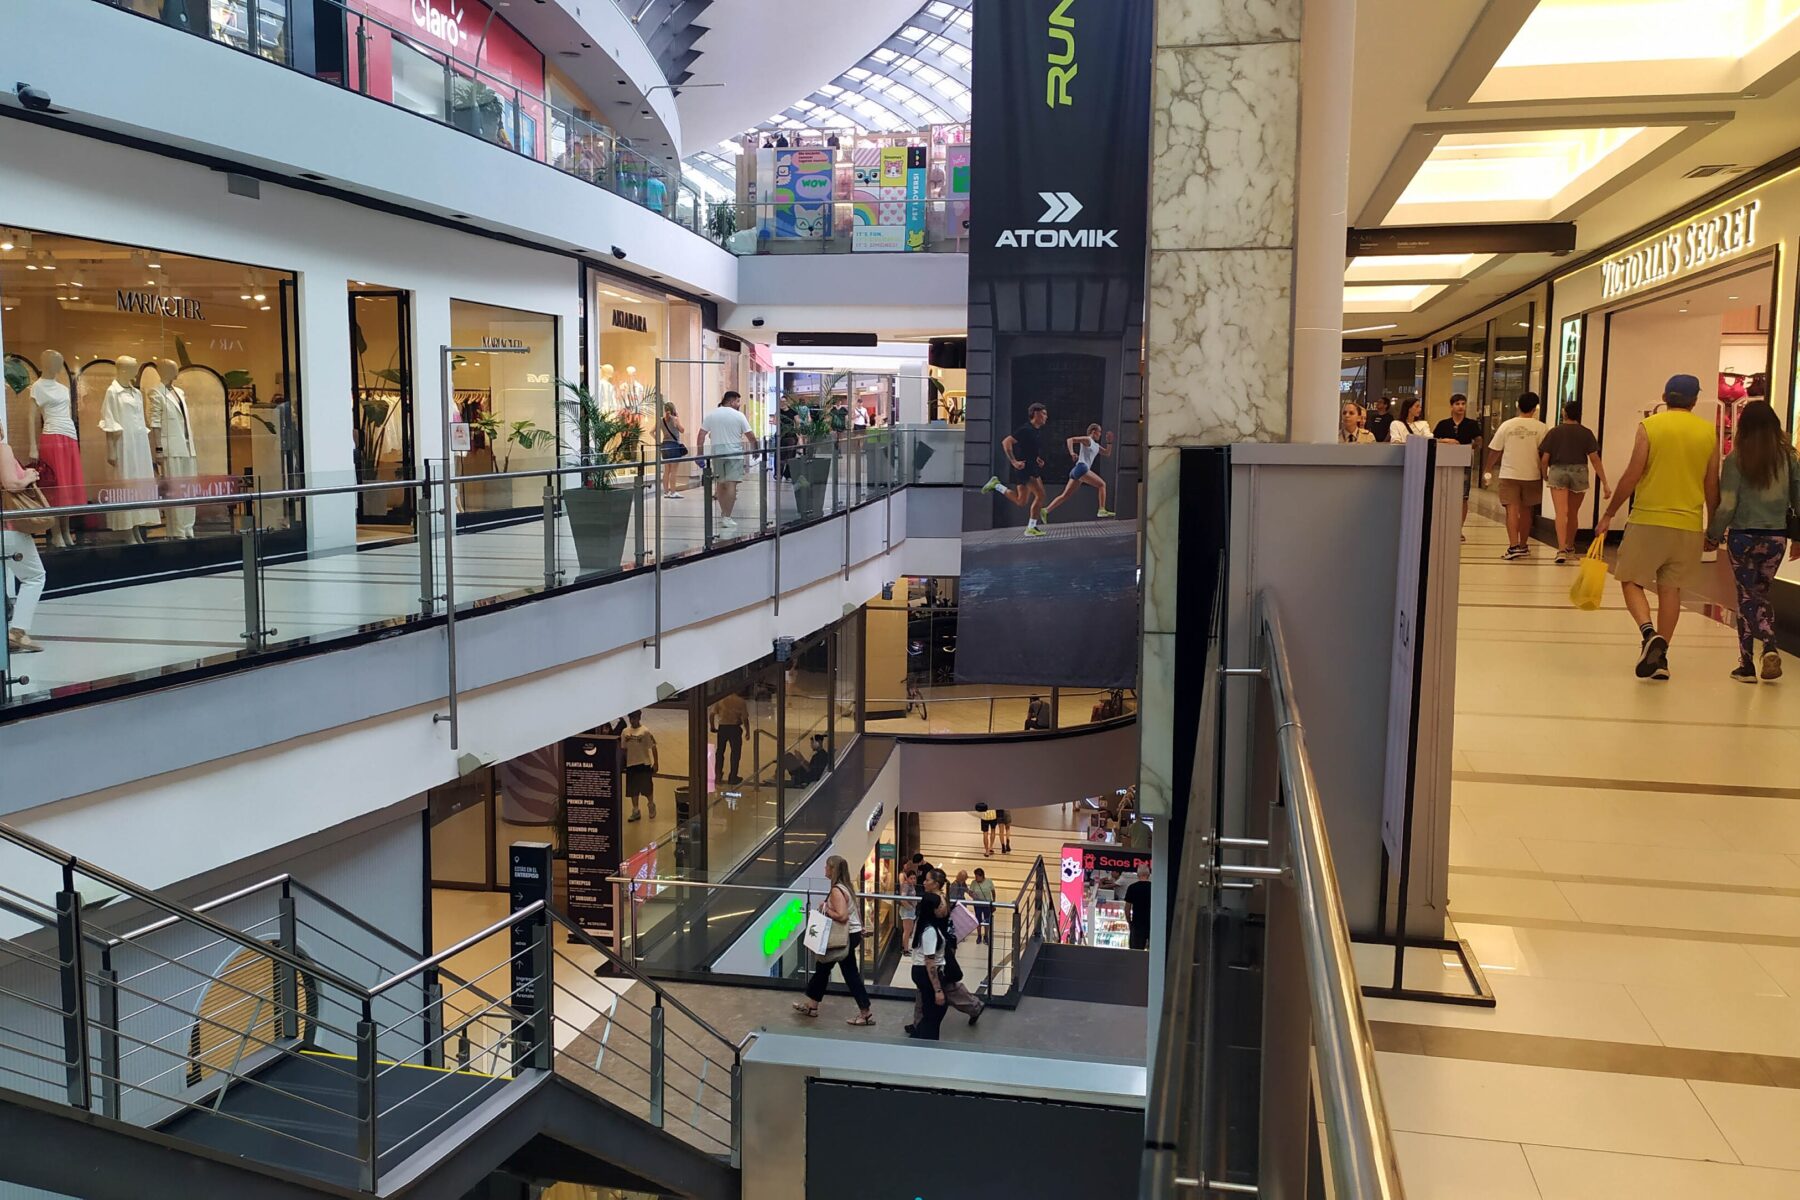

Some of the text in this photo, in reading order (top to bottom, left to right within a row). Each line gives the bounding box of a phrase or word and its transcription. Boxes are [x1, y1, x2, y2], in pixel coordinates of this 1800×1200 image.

[411, 0, 459, 47] Claro
[801, 179, 828, 188] WOW
[995, 229, 1119, 248] ATOMIK
[1600, 198, 1760, 298] VICTORIA'S SECRET
